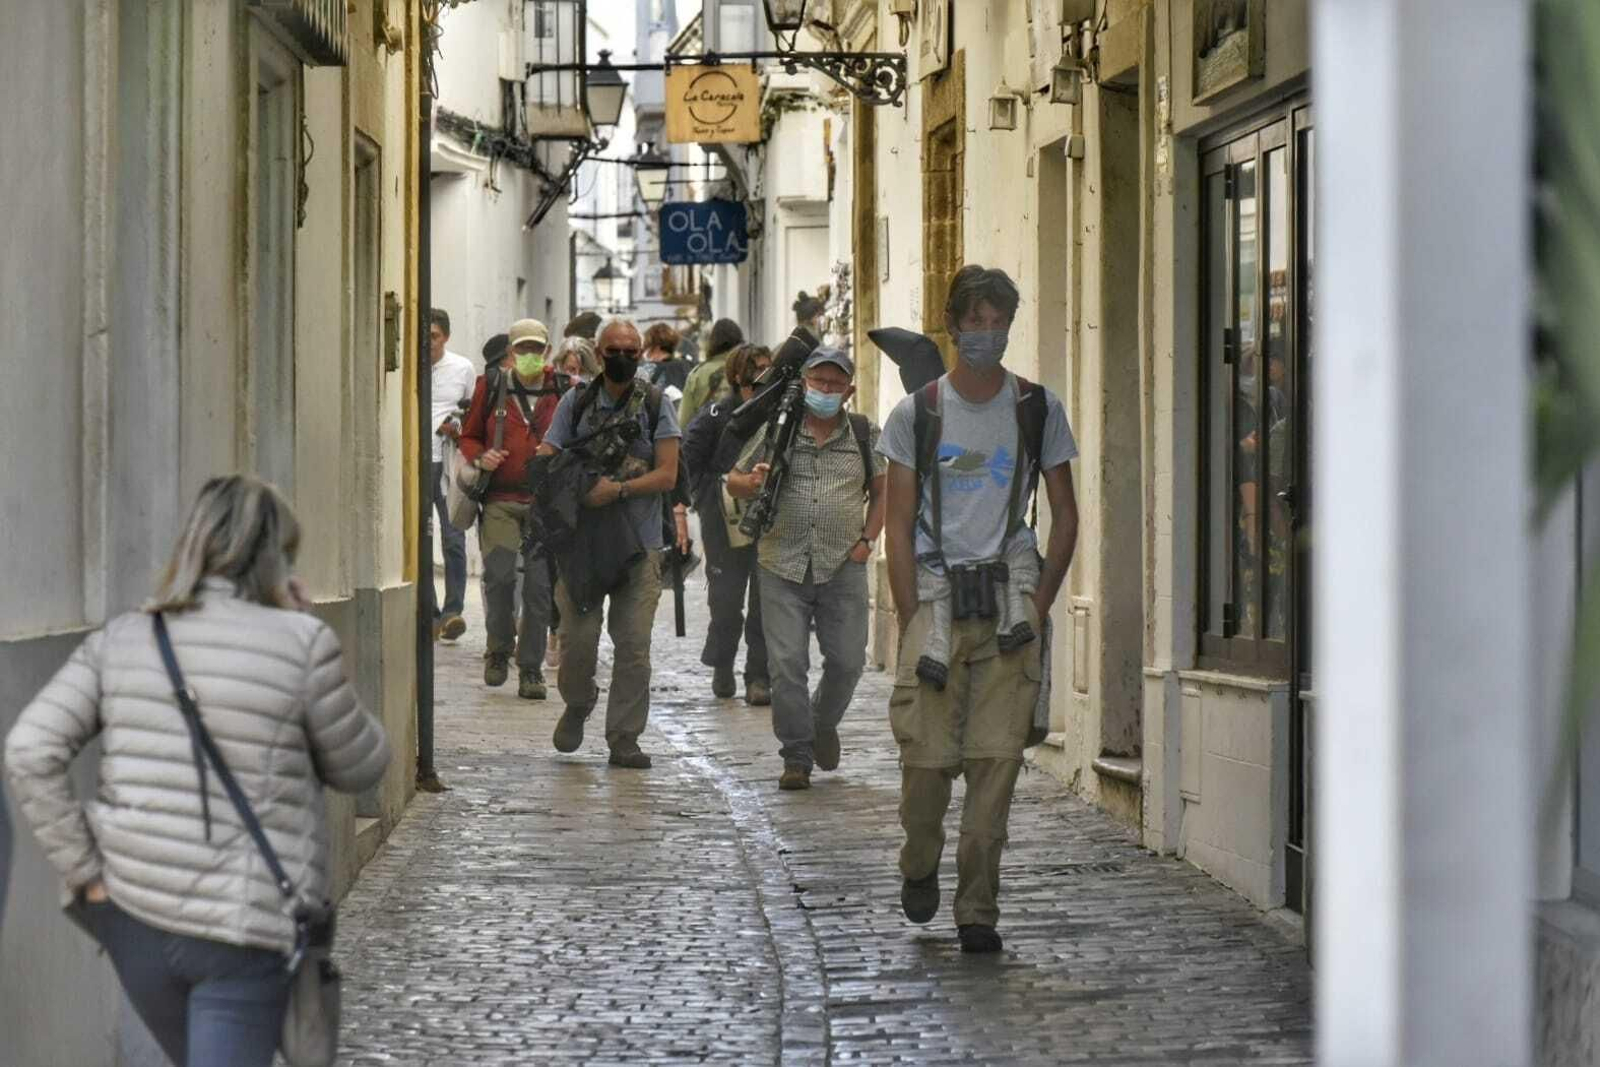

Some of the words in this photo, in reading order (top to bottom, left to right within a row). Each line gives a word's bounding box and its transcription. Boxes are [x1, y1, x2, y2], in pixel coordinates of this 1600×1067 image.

[683, 91, 698, 102] La
[668, 208, 723, 232] OLA
[687, 230, 742, 253] OLA
